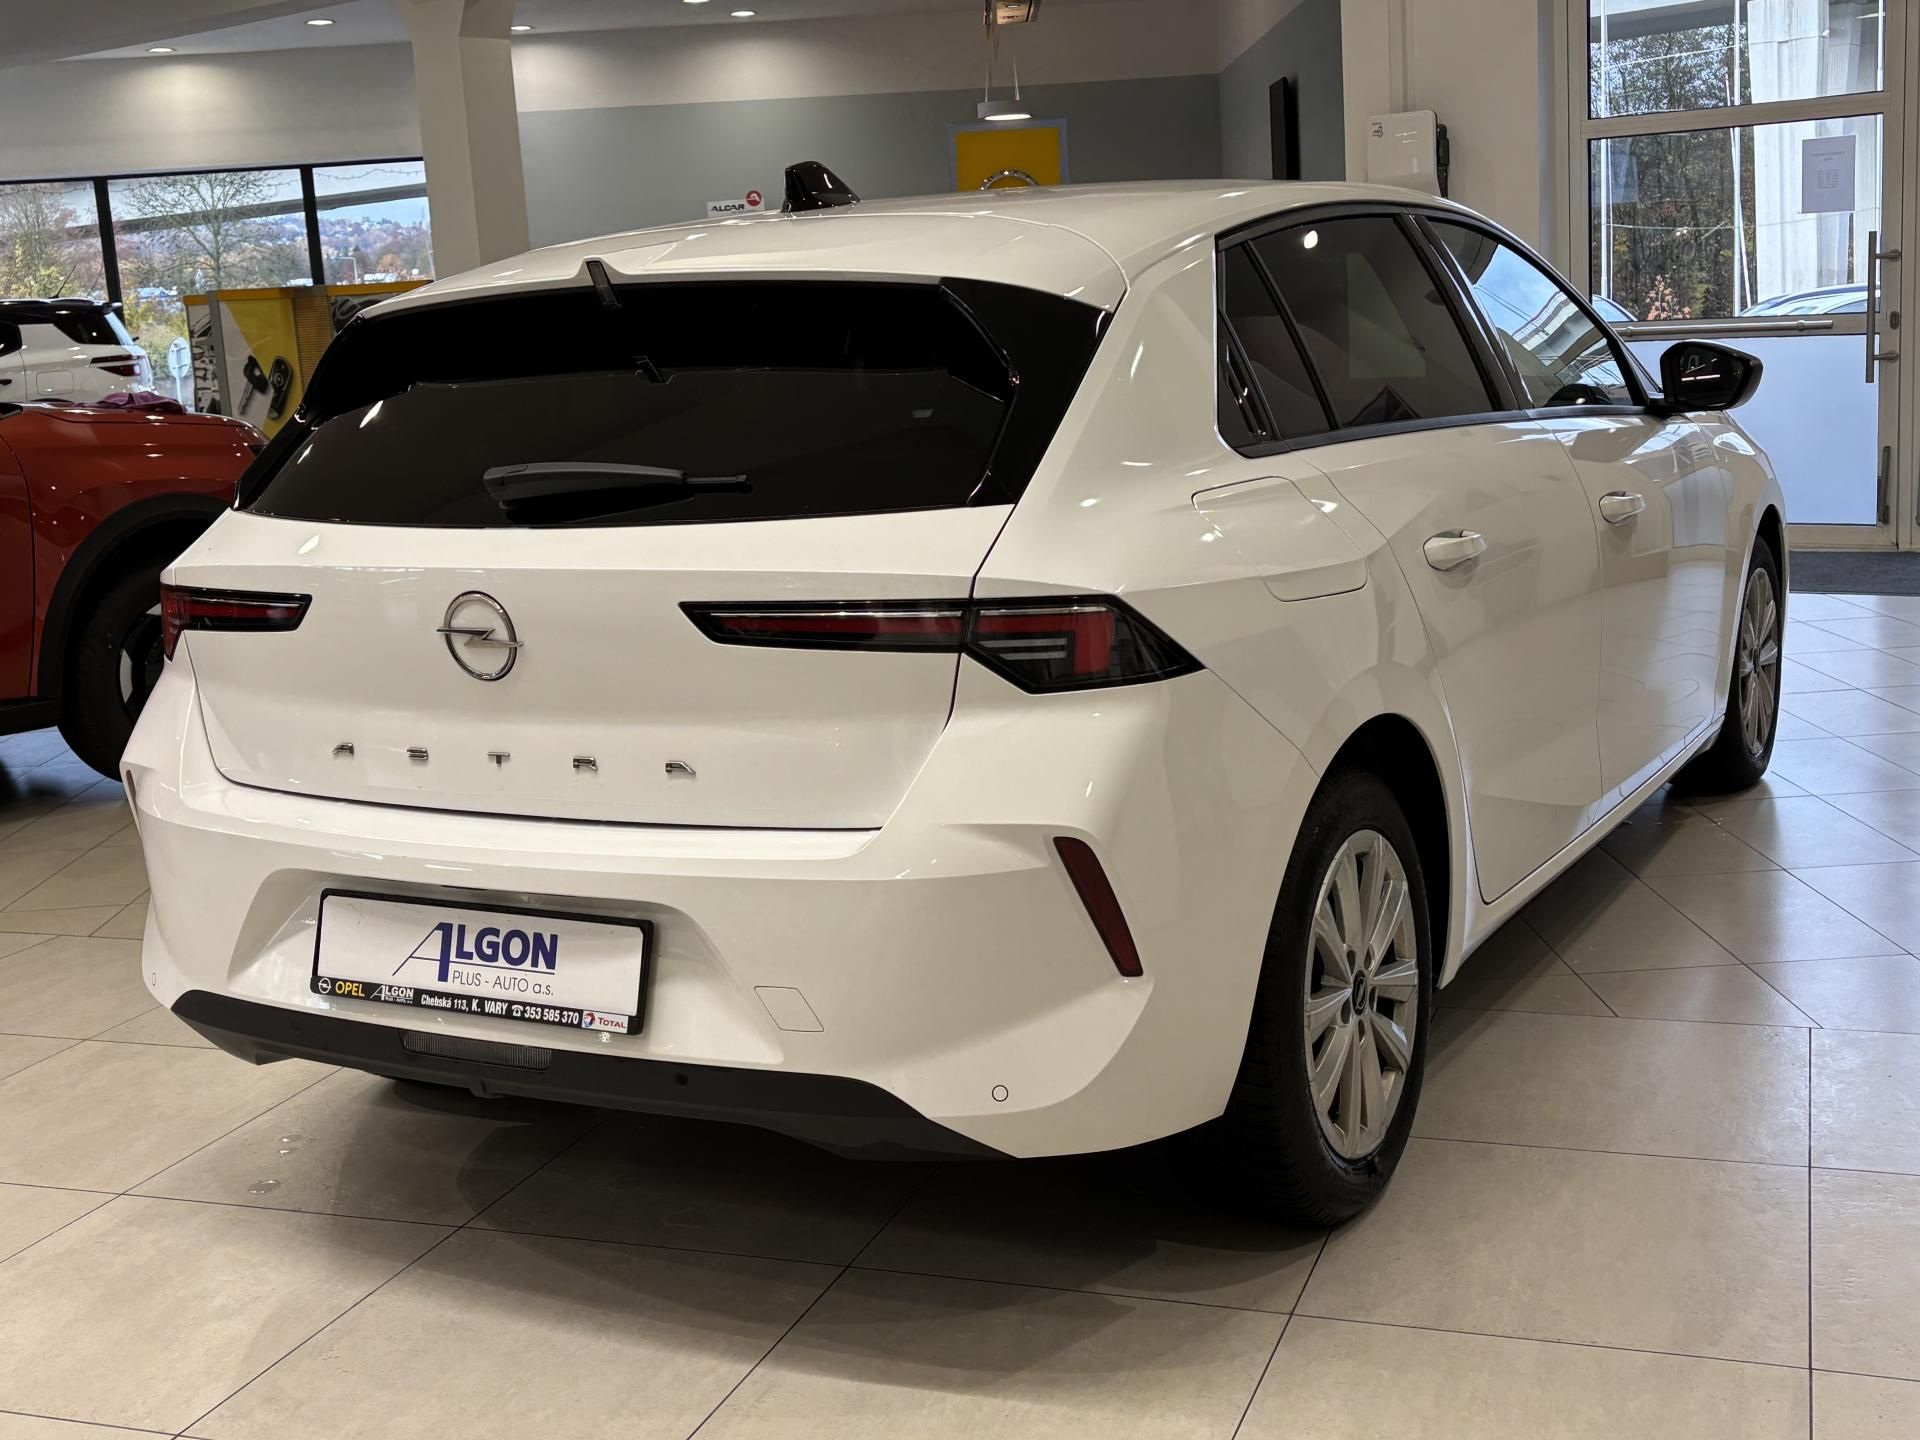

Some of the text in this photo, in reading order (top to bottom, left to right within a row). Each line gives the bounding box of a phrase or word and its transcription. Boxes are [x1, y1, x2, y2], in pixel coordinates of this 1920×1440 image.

[711, 204, 745, 212] ALCAR
[331, 742, 696, 776] ASTRA
[391, 922, 559, 982] ALGON
[335, 980, 366, 998] OPEL
[369, 984, 415, 1001] ALGON
[452, 970, 482, 987] PLUS
[492, 975, 529, 993] AUTO
[532, 982, 554, 996] a.s.
[421, 994, 452, 1009] Chebská
[453, 998, 469, 1012] 113,
[471, 998, 481, 1012] K.
[484, 1000, 509, 1016] VARY
[524, 1005, 542, 1020] 353
[543, 1008, 561, 1023] 585
[561, 1010, 580, 1025] 370
[597, 1016, 627, 1029] TOTAL
